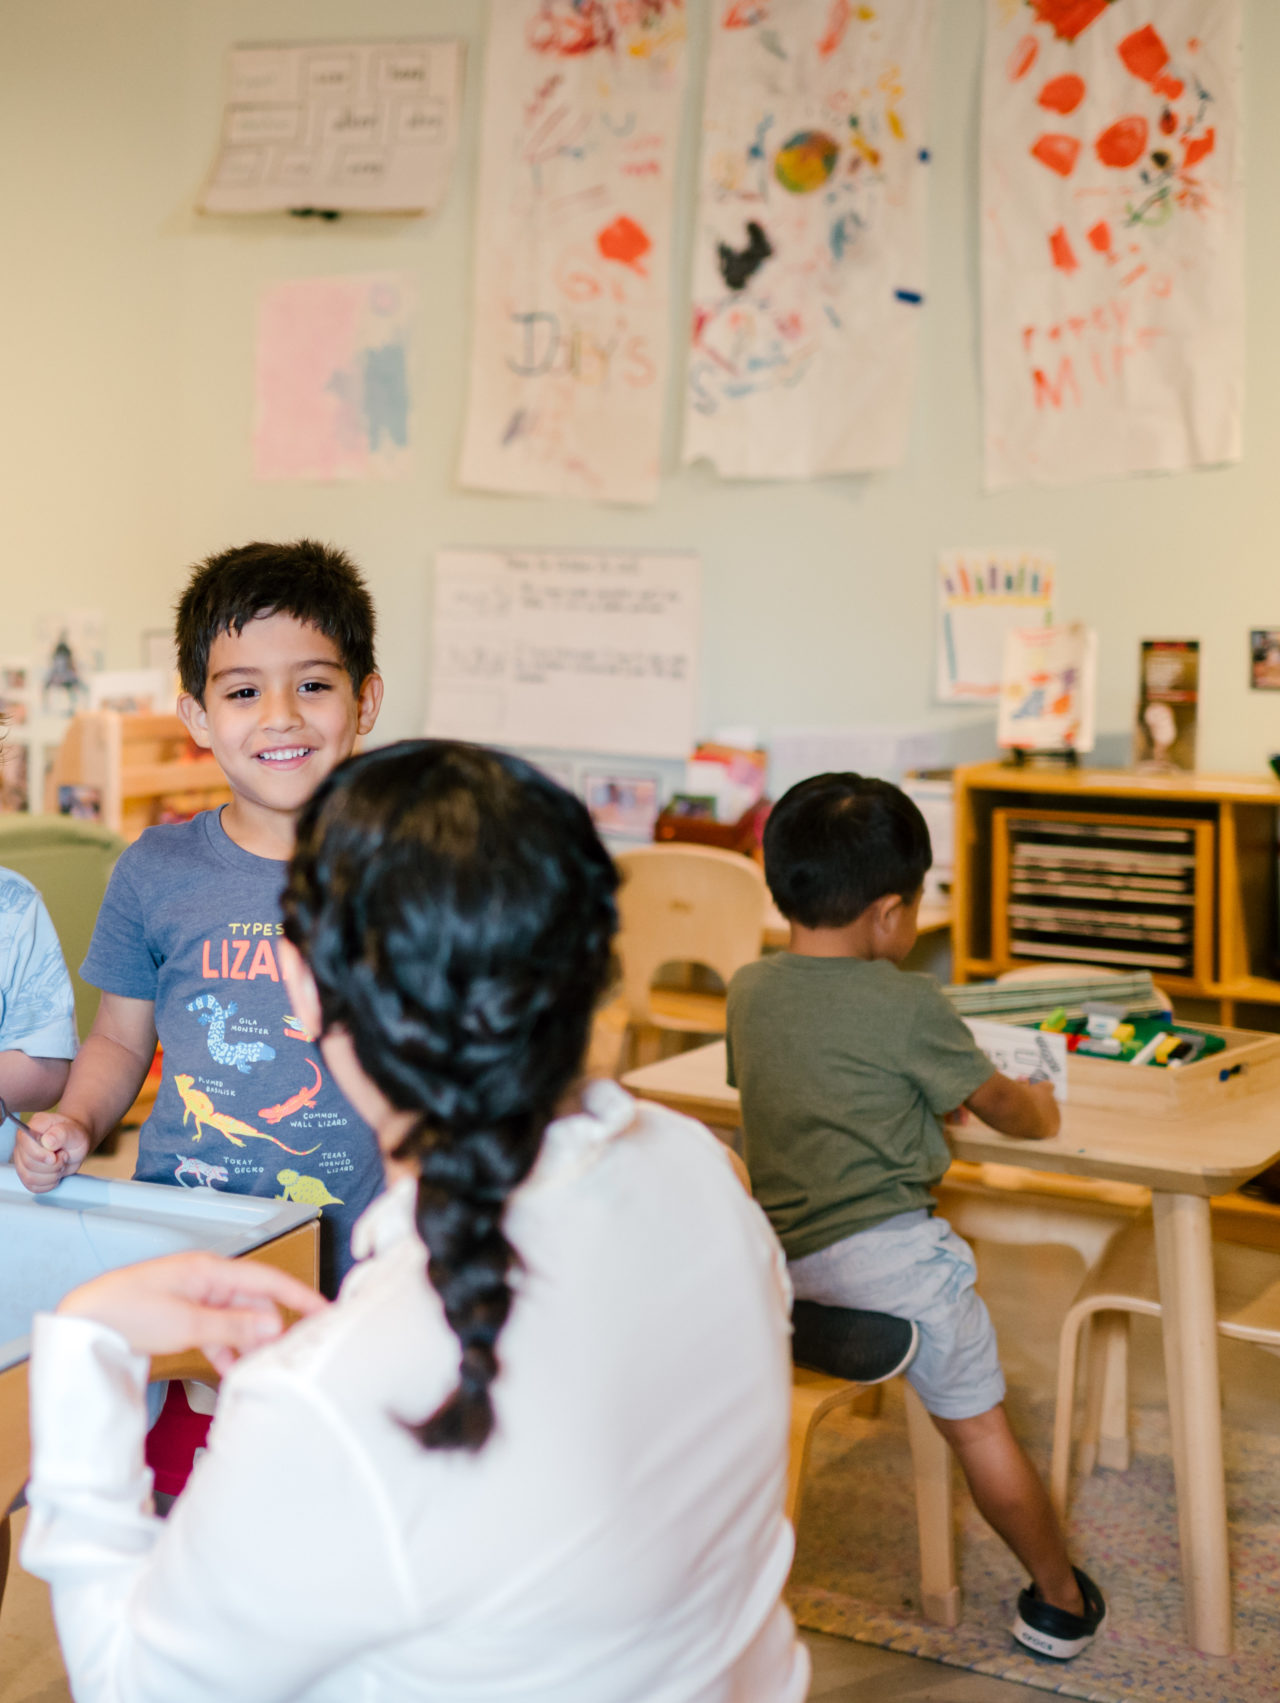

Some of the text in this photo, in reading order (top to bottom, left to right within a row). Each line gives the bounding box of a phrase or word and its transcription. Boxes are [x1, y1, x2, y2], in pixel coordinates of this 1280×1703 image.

[228, 922, 285, 936] TYPES
[202, 939, 286, 982] LIZA
[238, 1017, 258, 1026] GILA
[230, 1025, 270, 1035] MONSTER
[198, 1076, 224, 1088] PLUMED
[206, 1086, 236, 1097] BASILISK
[303, 1112, 338, 1120] COMMON
[318, 1119, 348, 1128] LIZARD
[223, 1156, 253, 1166] TOKAY
[234, 1166, 265, 1175] GECKO
